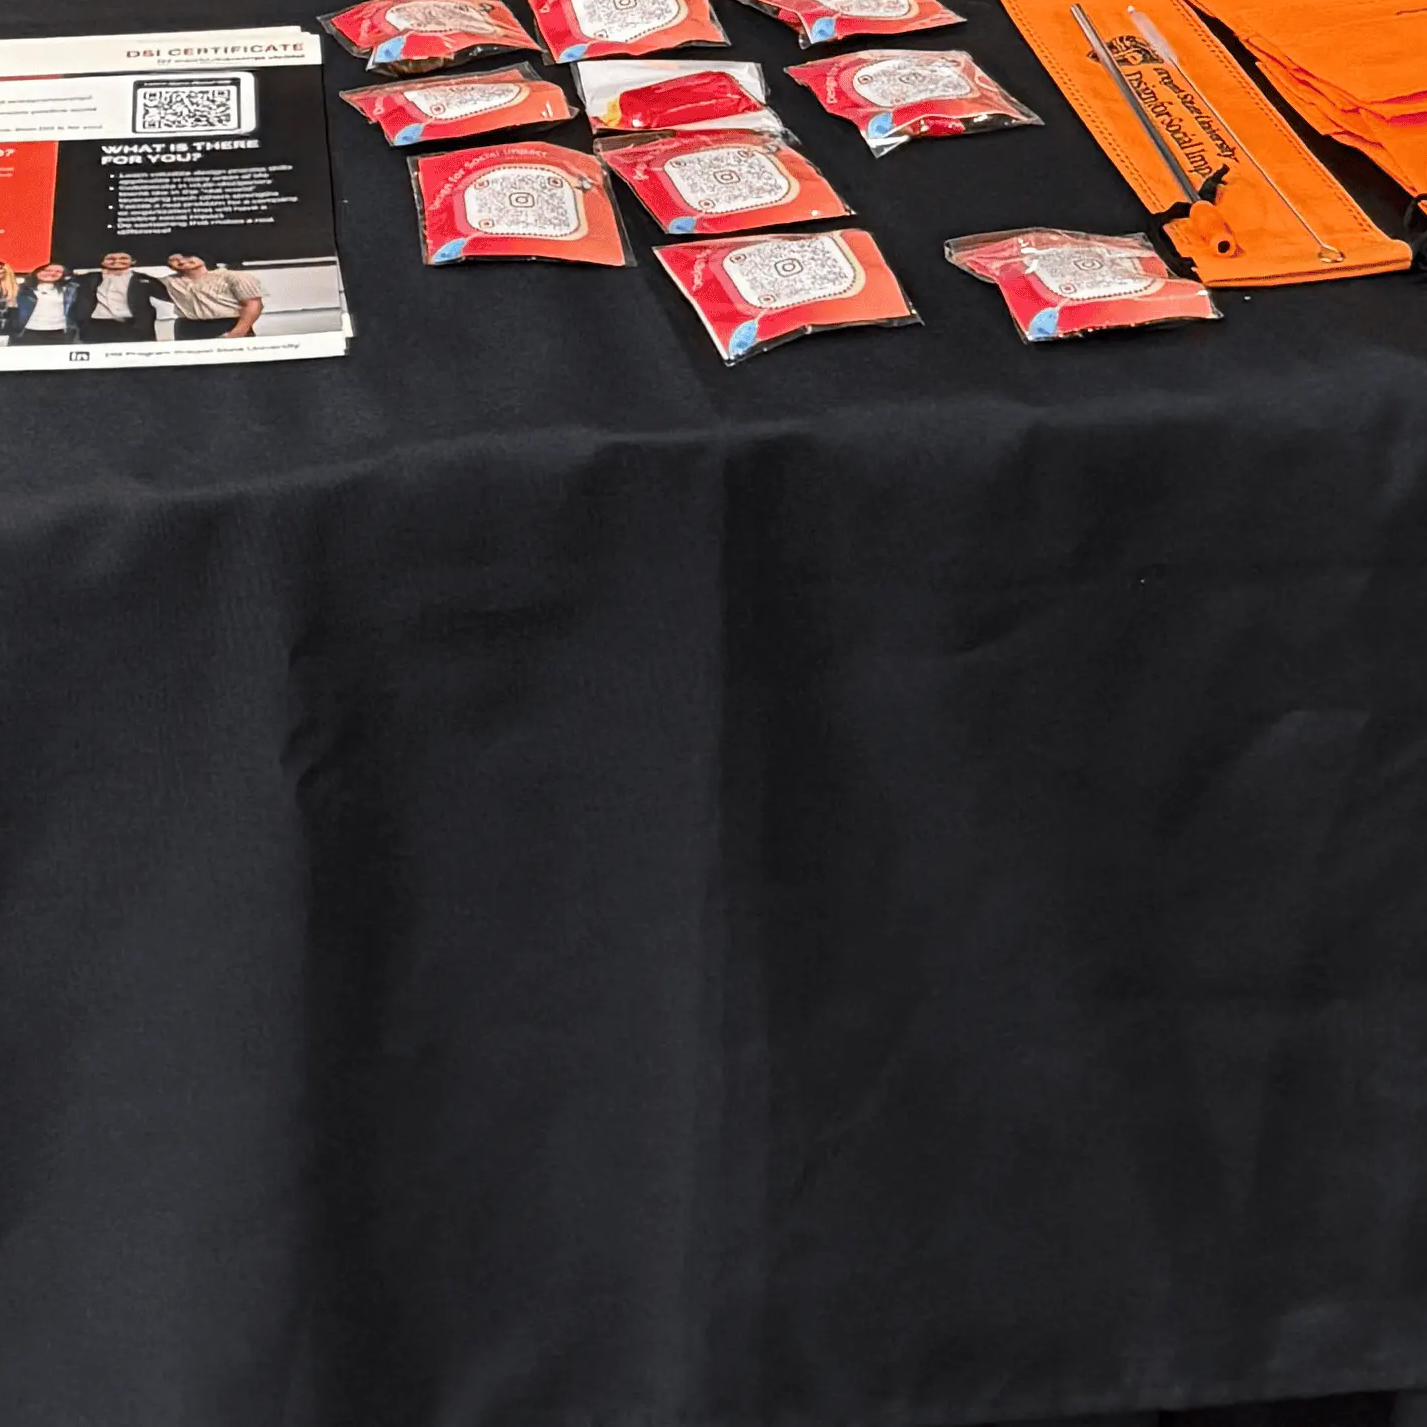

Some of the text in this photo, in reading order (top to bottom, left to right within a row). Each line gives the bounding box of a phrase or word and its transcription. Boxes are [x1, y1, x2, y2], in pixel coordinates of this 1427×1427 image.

[168, 43, 305, 56] CERTIFICATE
[101, 139, 260, 154] WHAT IS THERE
[101, 153, 202, 165] FOR YOU?
